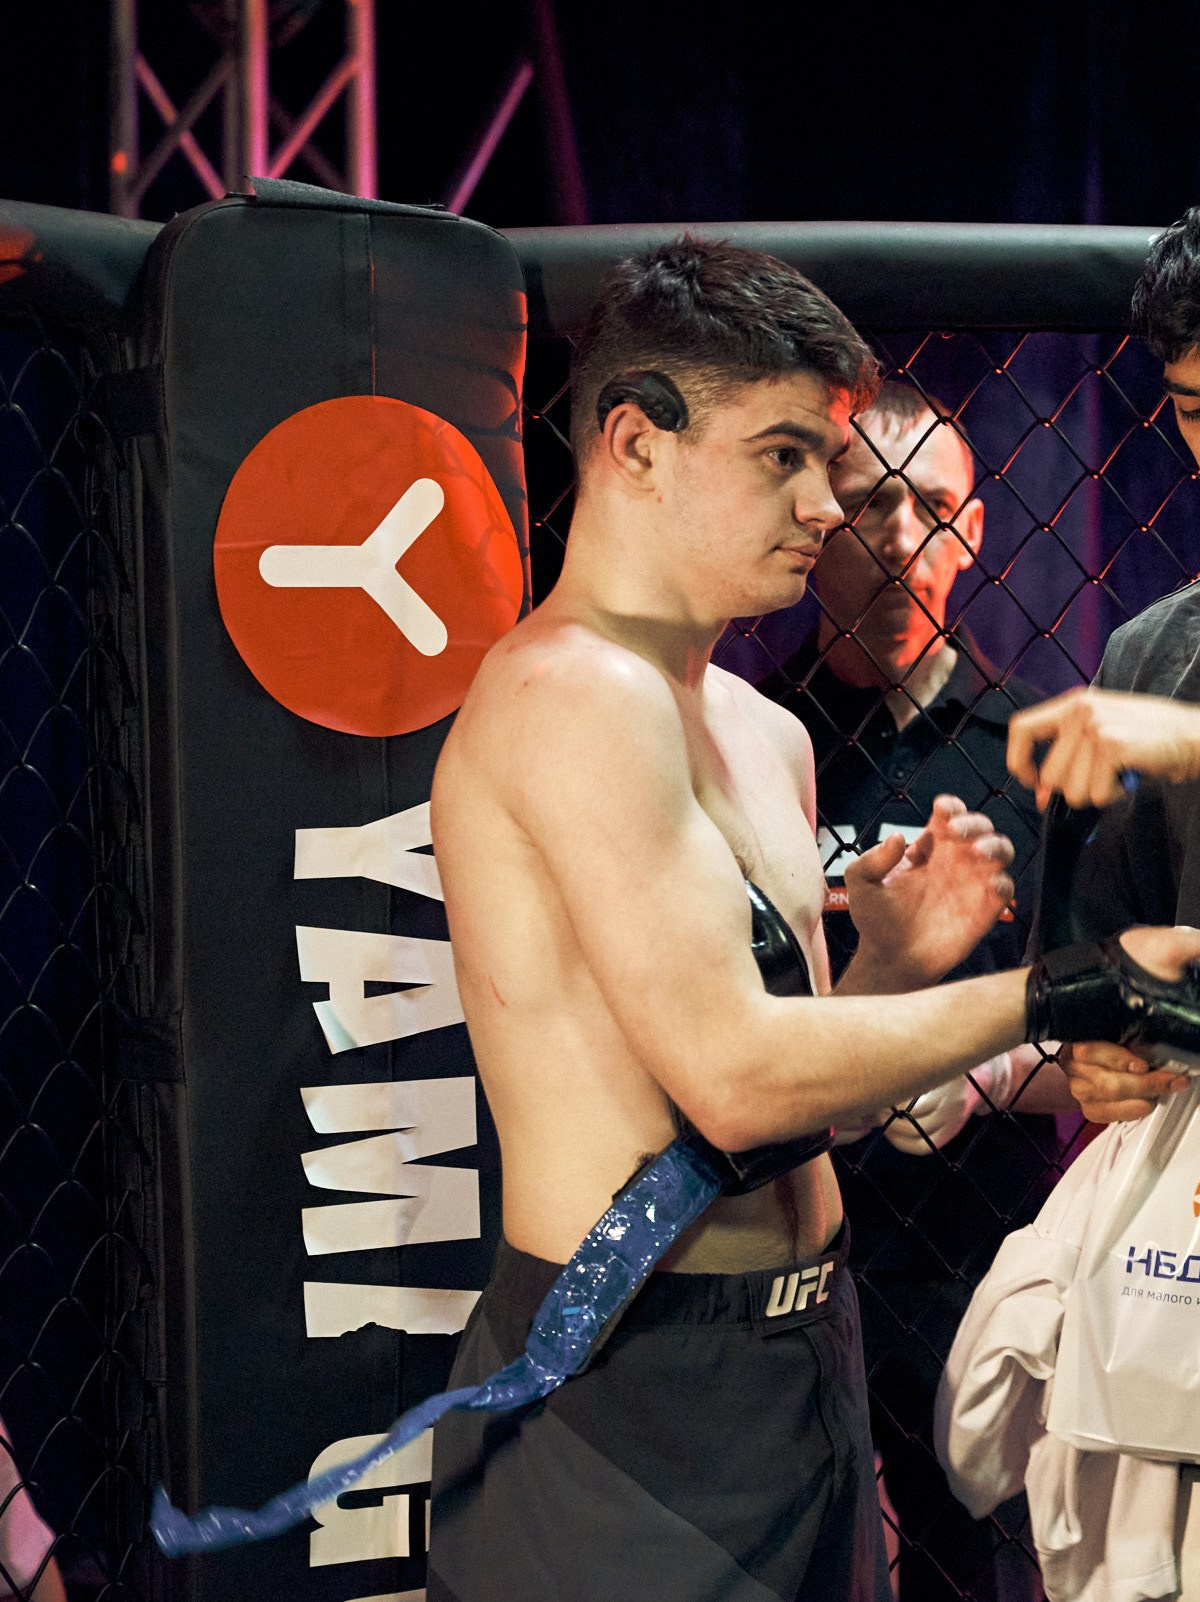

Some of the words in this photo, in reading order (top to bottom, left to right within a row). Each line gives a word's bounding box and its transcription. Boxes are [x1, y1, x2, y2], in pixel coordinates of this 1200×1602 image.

[765, 1260, 835, 1318] UFC
[1121, 1285, 1143, 1298] для
[1146, 1291, 1192, 1306] малого
